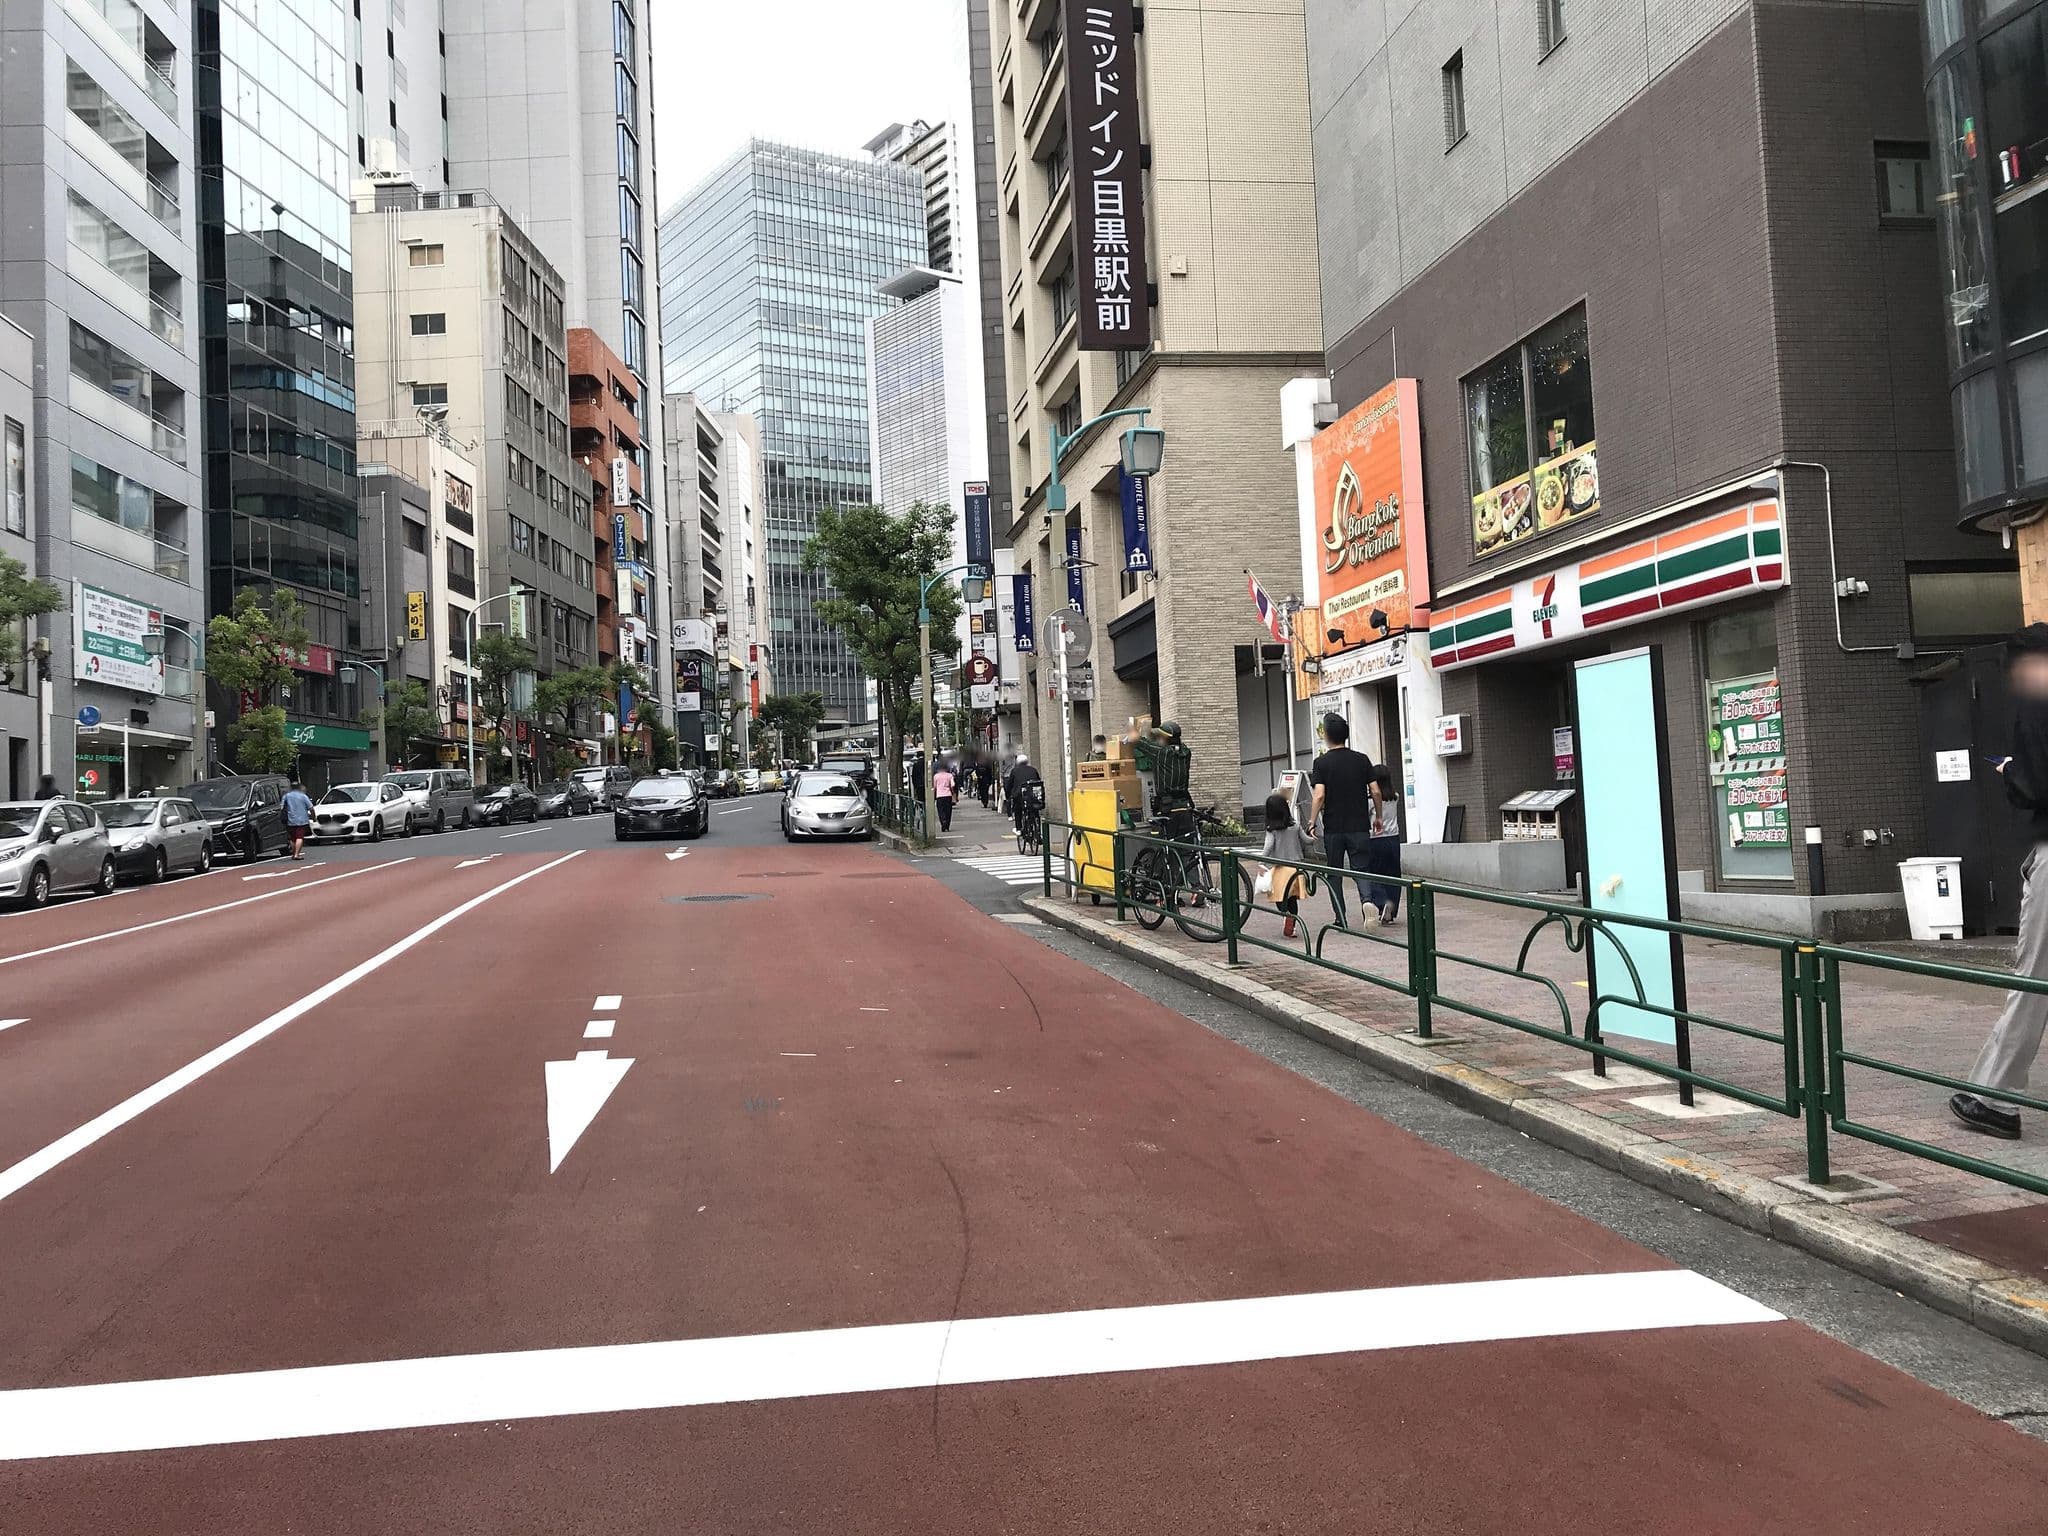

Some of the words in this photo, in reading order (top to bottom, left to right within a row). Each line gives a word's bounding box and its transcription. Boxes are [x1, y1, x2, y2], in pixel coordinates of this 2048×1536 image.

[1085, 8, 1132, 331] ミッドイン目黒駅前
[1135, 477, 1144, 504] HOTEL
[1137, 505, 1145, 521] MID
[1138, 523, 1146, 532] IN
[1347, 493, 1400, 540] Bangkok
[1348, 519, 1402, 566] Oriental
[1328, 599, 1341, 614] Thai
[1341, 589, 1371, 610] Restaurant
[1374, 576, 1399, 596] タイ国料理
[1324, 664, 1355, 685] Bangkok
[1356, 653, 1386, 675] Oriental
